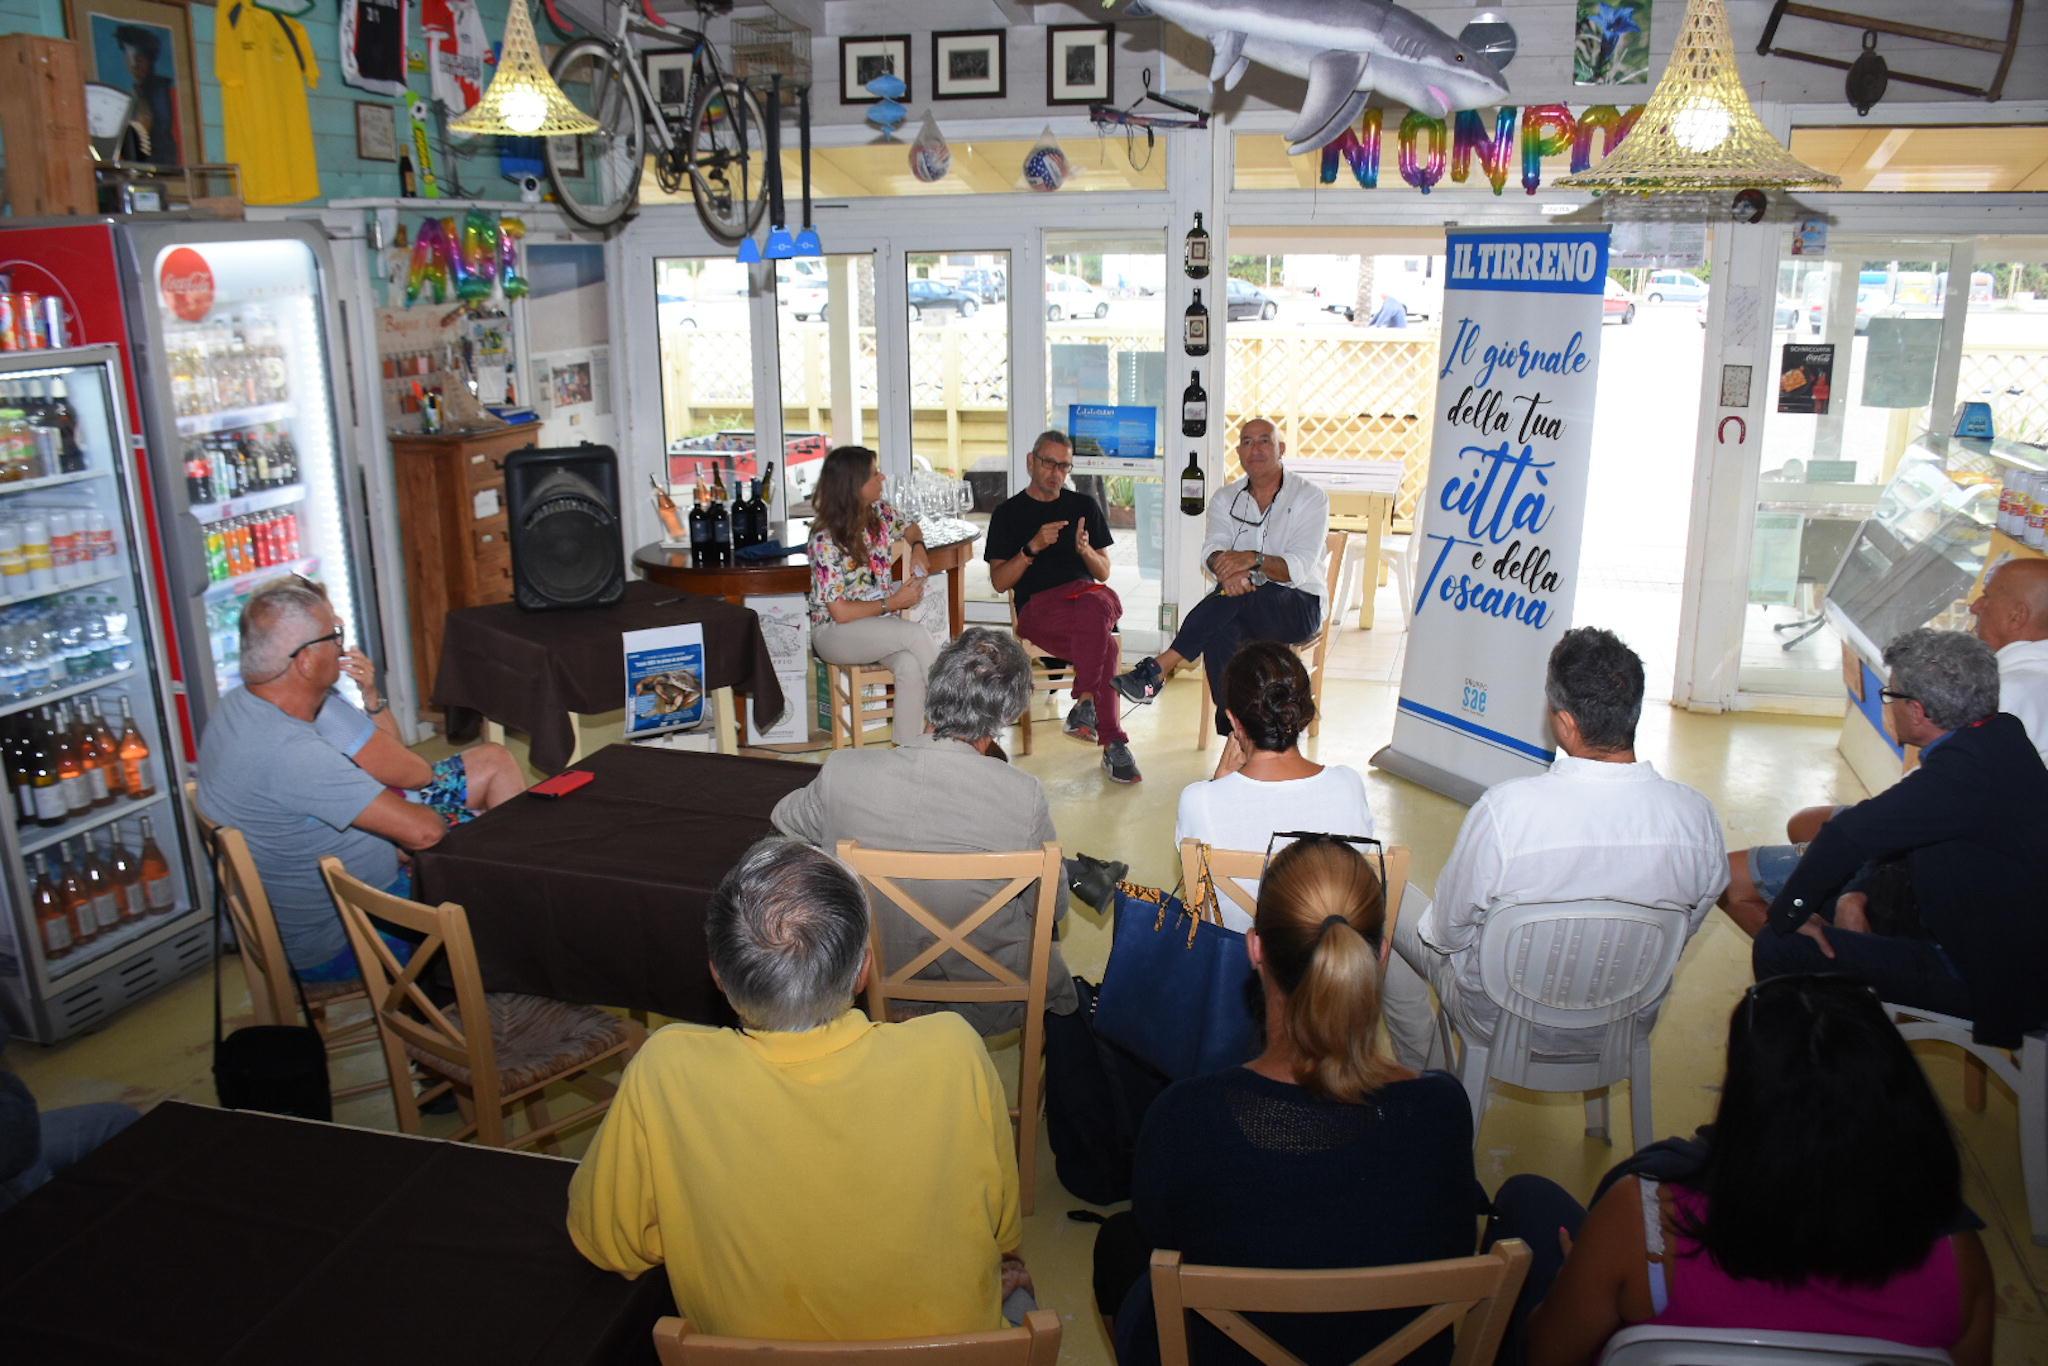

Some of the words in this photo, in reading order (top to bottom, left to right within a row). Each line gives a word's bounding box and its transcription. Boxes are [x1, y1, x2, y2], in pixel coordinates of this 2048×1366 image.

[1452, 243, 1476, 279] IL
[1477, 241, 1598, 283] TIRRENO
[1440, 317, 1481, 380] Il
[1473, 331, 1591, 389] giornale
[1447, 385, 1514, 436] della
[1440, 441, 1556, 545] città
[1414, 533, 1556, 630] Toscana
[1471, 550, 1486, 570] e
[1492, 540, 1565, 594] della
